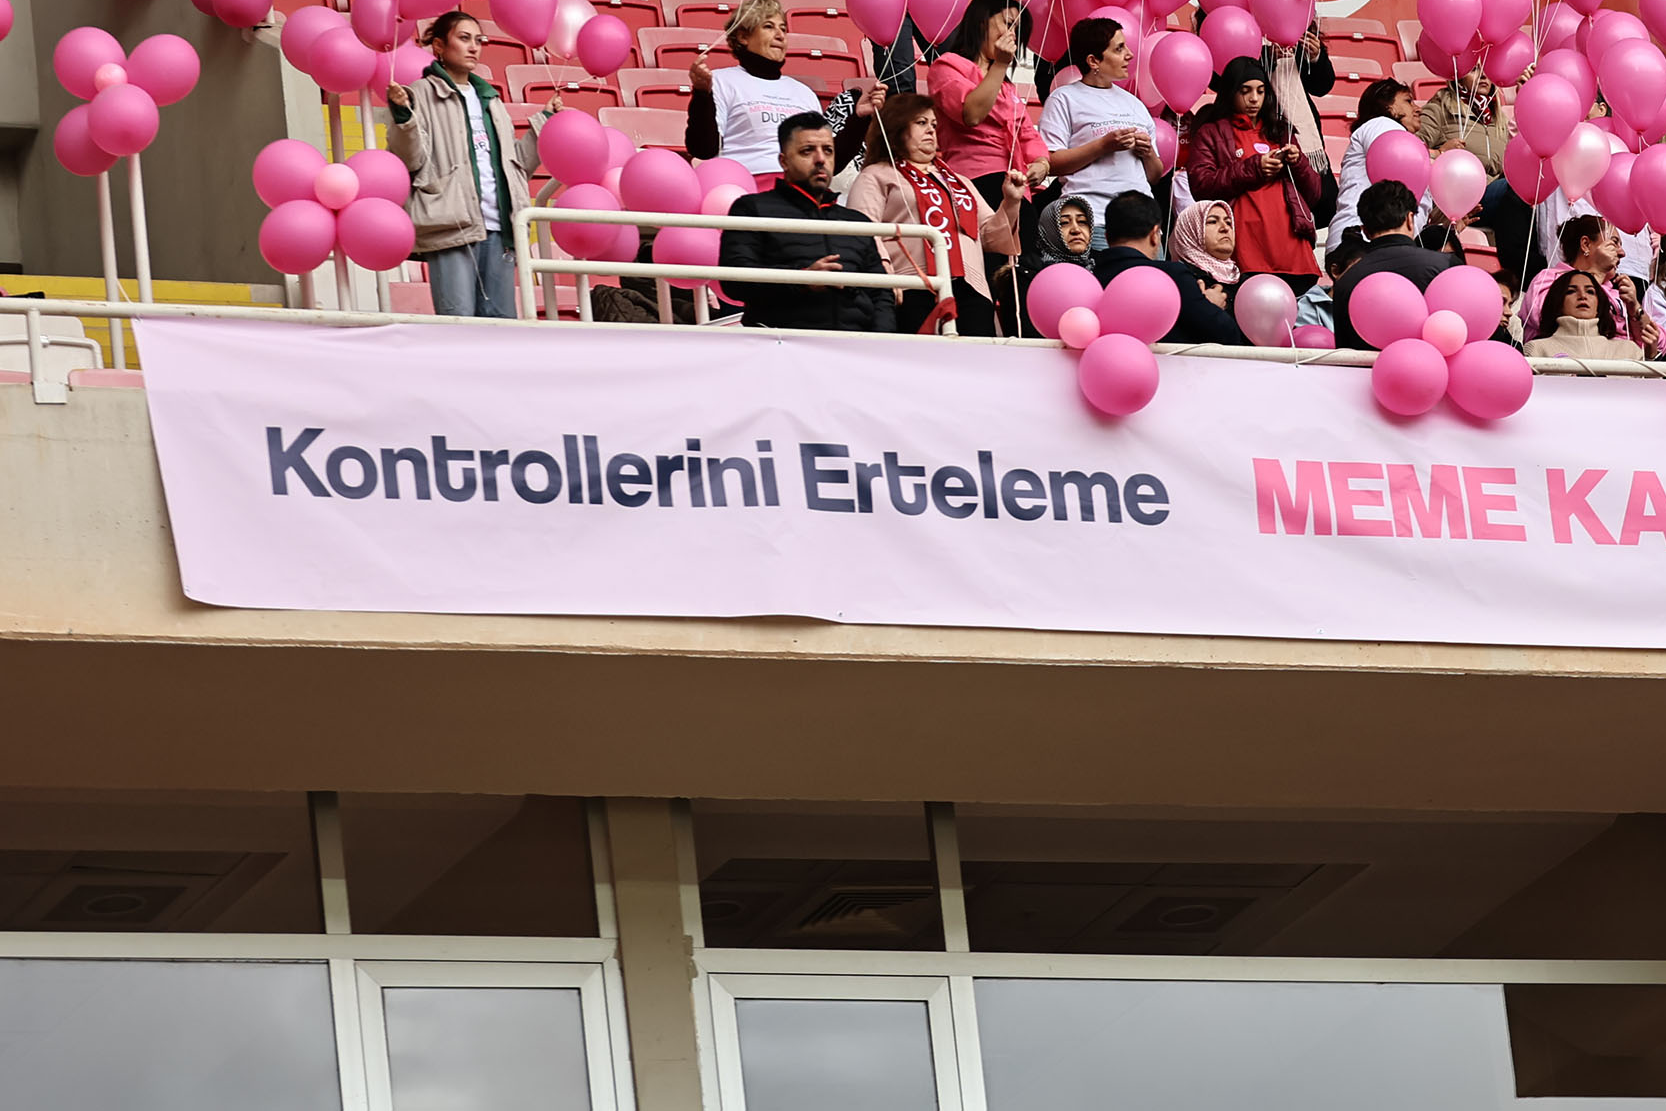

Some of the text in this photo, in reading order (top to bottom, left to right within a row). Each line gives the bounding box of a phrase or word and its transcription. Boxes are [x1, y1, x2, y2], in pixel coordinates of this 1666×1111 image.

[265, 426, 780, 508] Kontrollerini
[799, 442, 1170, 526] Erteleme
[1252, 457, 1527, 542] MEME
